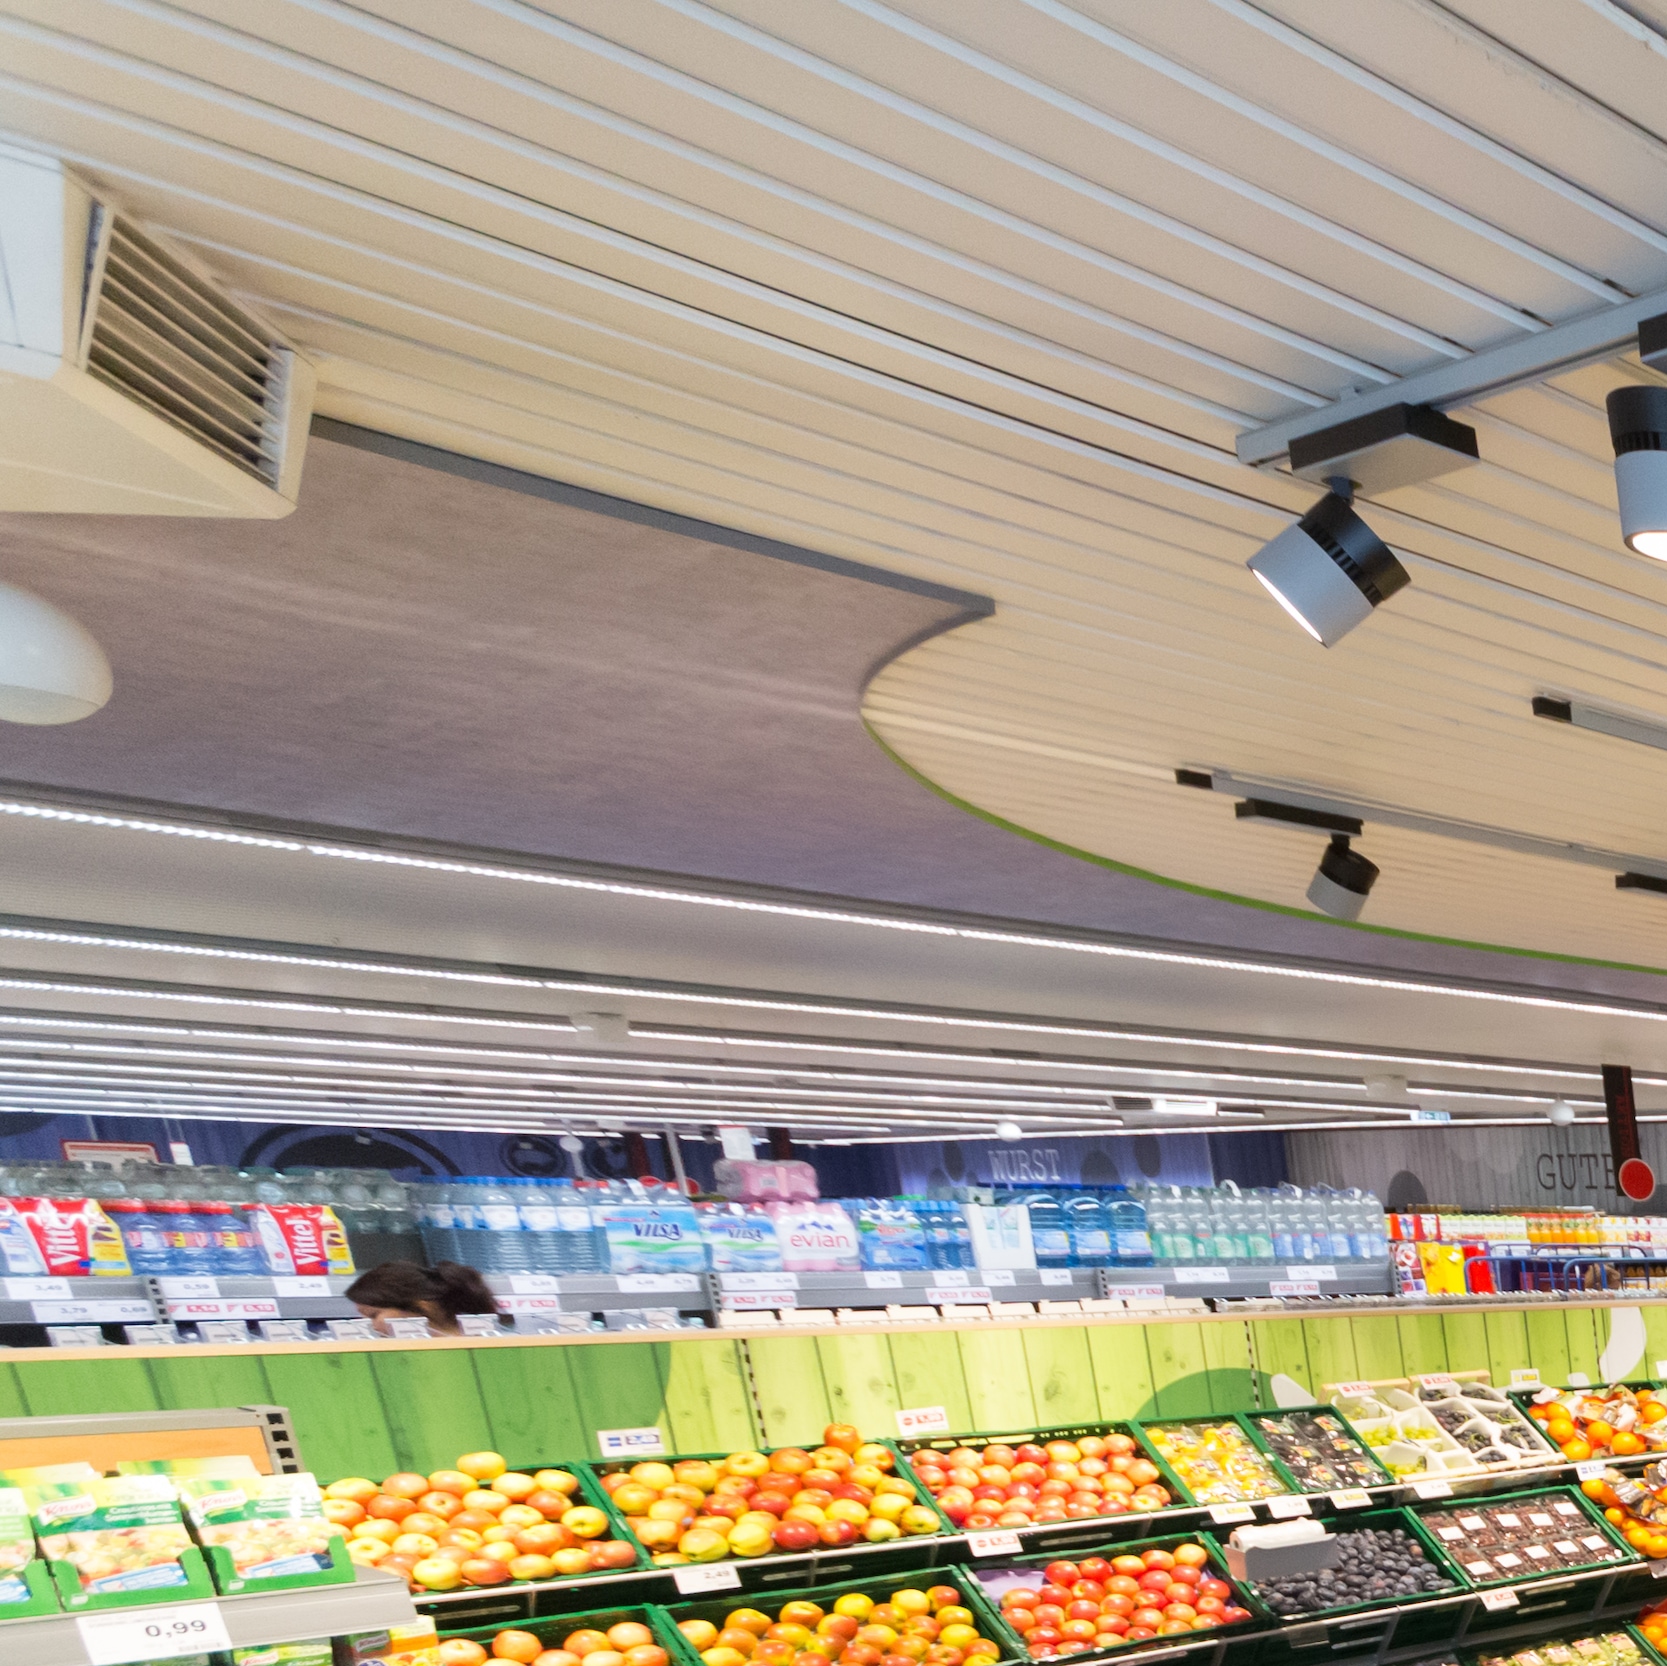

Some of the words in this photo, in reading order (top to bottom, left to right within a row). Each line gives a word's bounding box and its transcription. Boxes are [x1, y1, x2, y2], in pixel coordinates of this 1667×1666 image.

[285, 1218, 322, 1265] Vittel
[633, 1223, 683, 1241] VILSA
[790, 1232, 851, 1249] evian
[145, 1618, 207, 1640] 0,99
